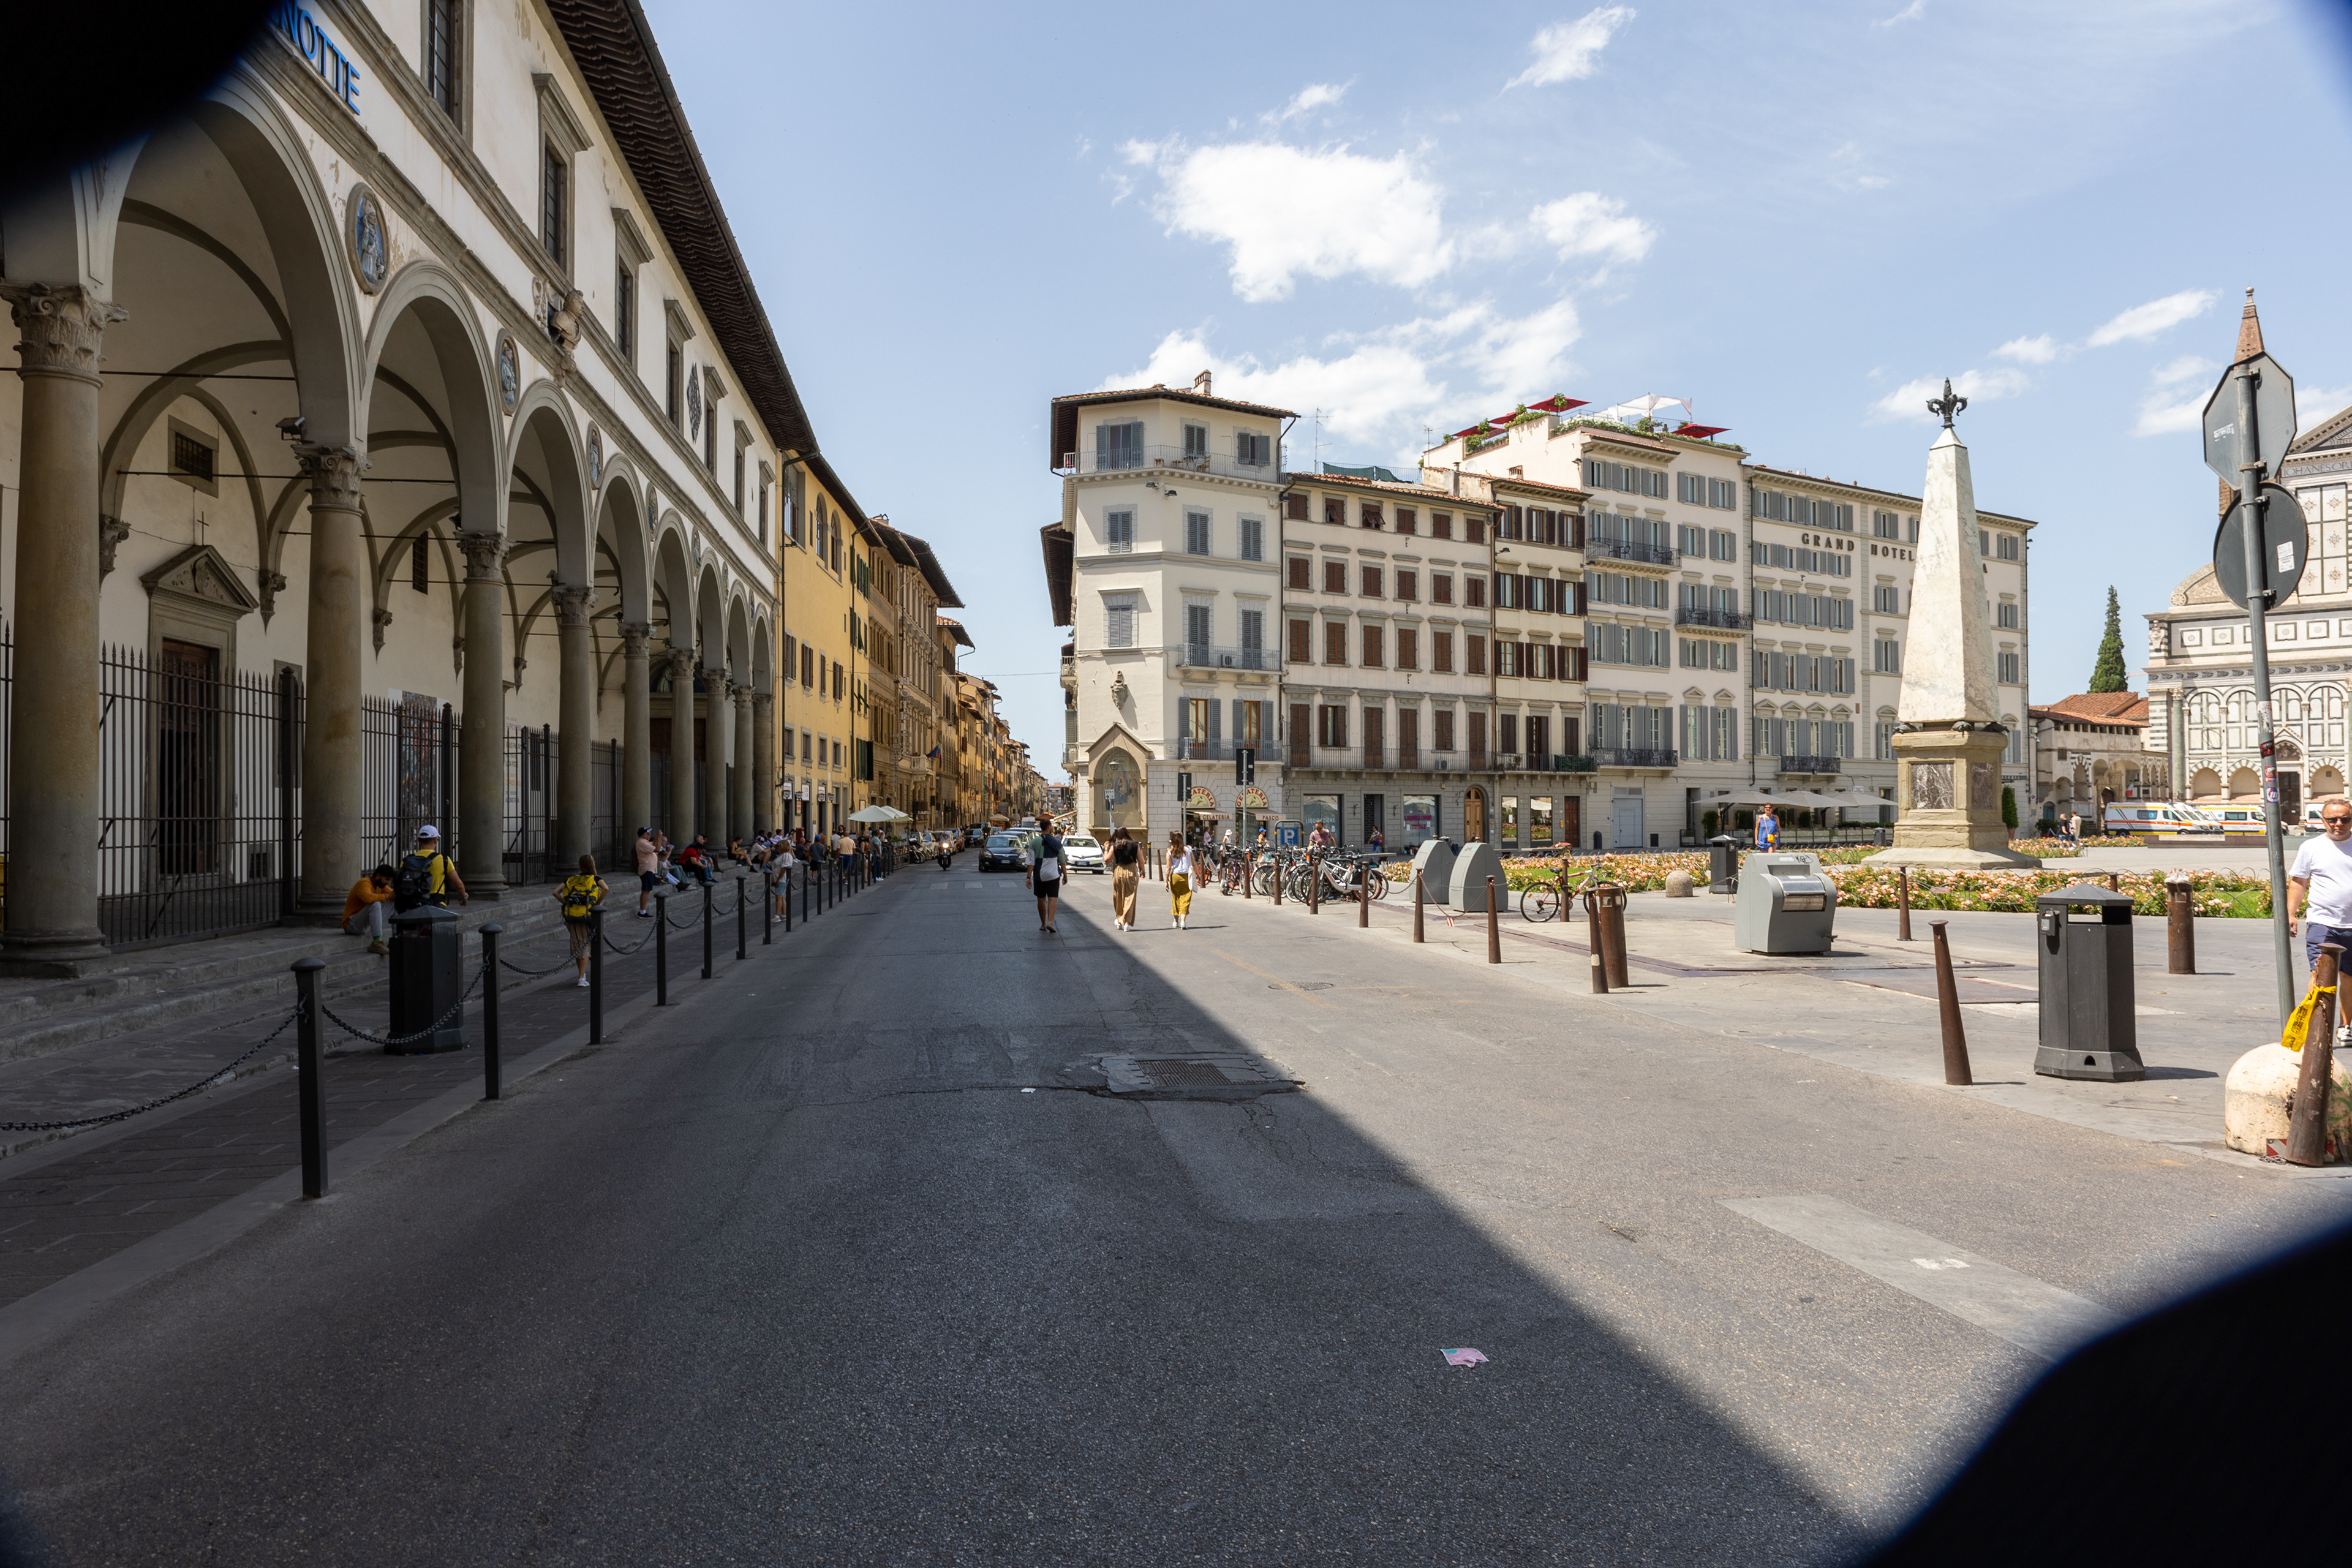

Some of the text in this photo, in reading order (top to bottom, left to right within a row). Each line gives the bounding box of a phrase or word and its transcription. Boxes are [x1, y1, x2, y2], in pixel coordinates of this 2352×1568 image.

[1801, 533, 1915, 561] GRAND HOTEL
[900, 676, 911, 732] HOTEL
[1284, 829, 1294, 843] P
